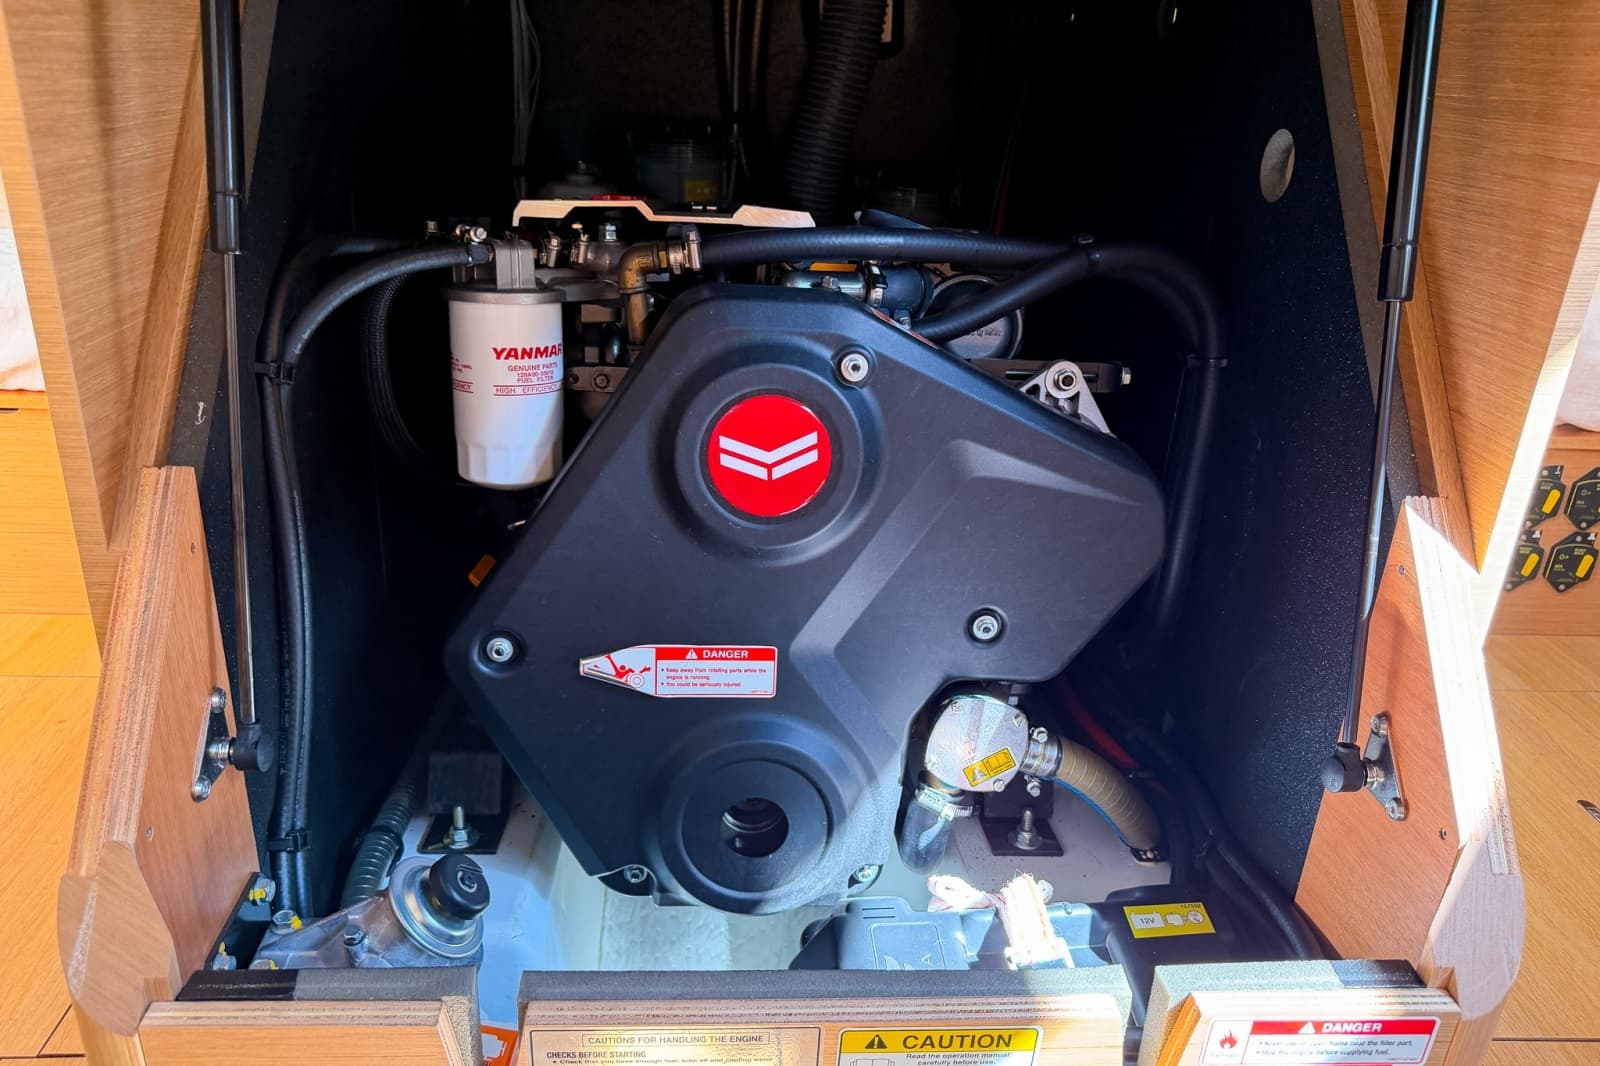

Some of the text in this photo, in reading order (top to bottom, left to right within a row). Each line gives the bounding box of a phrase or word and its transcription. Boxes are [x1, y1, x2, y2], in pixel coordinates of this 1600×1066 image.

[507, 364, 540, 372] GENUINE
[703, 649, 749, 659] DANGER
[1140, 917, 1155, 925] 12V
[1321, 1022, 1383, 1034] DANGER
[588, 1035, 764, 1045] CAUTIONS FOR HANDLING THE ENGINE
[902, 1033, 1013, 1050] CAUTION
[546, 1050, 647, 1059] CHECKS BEFORE STARTING
[942, 1052, 979, 1060] operation
